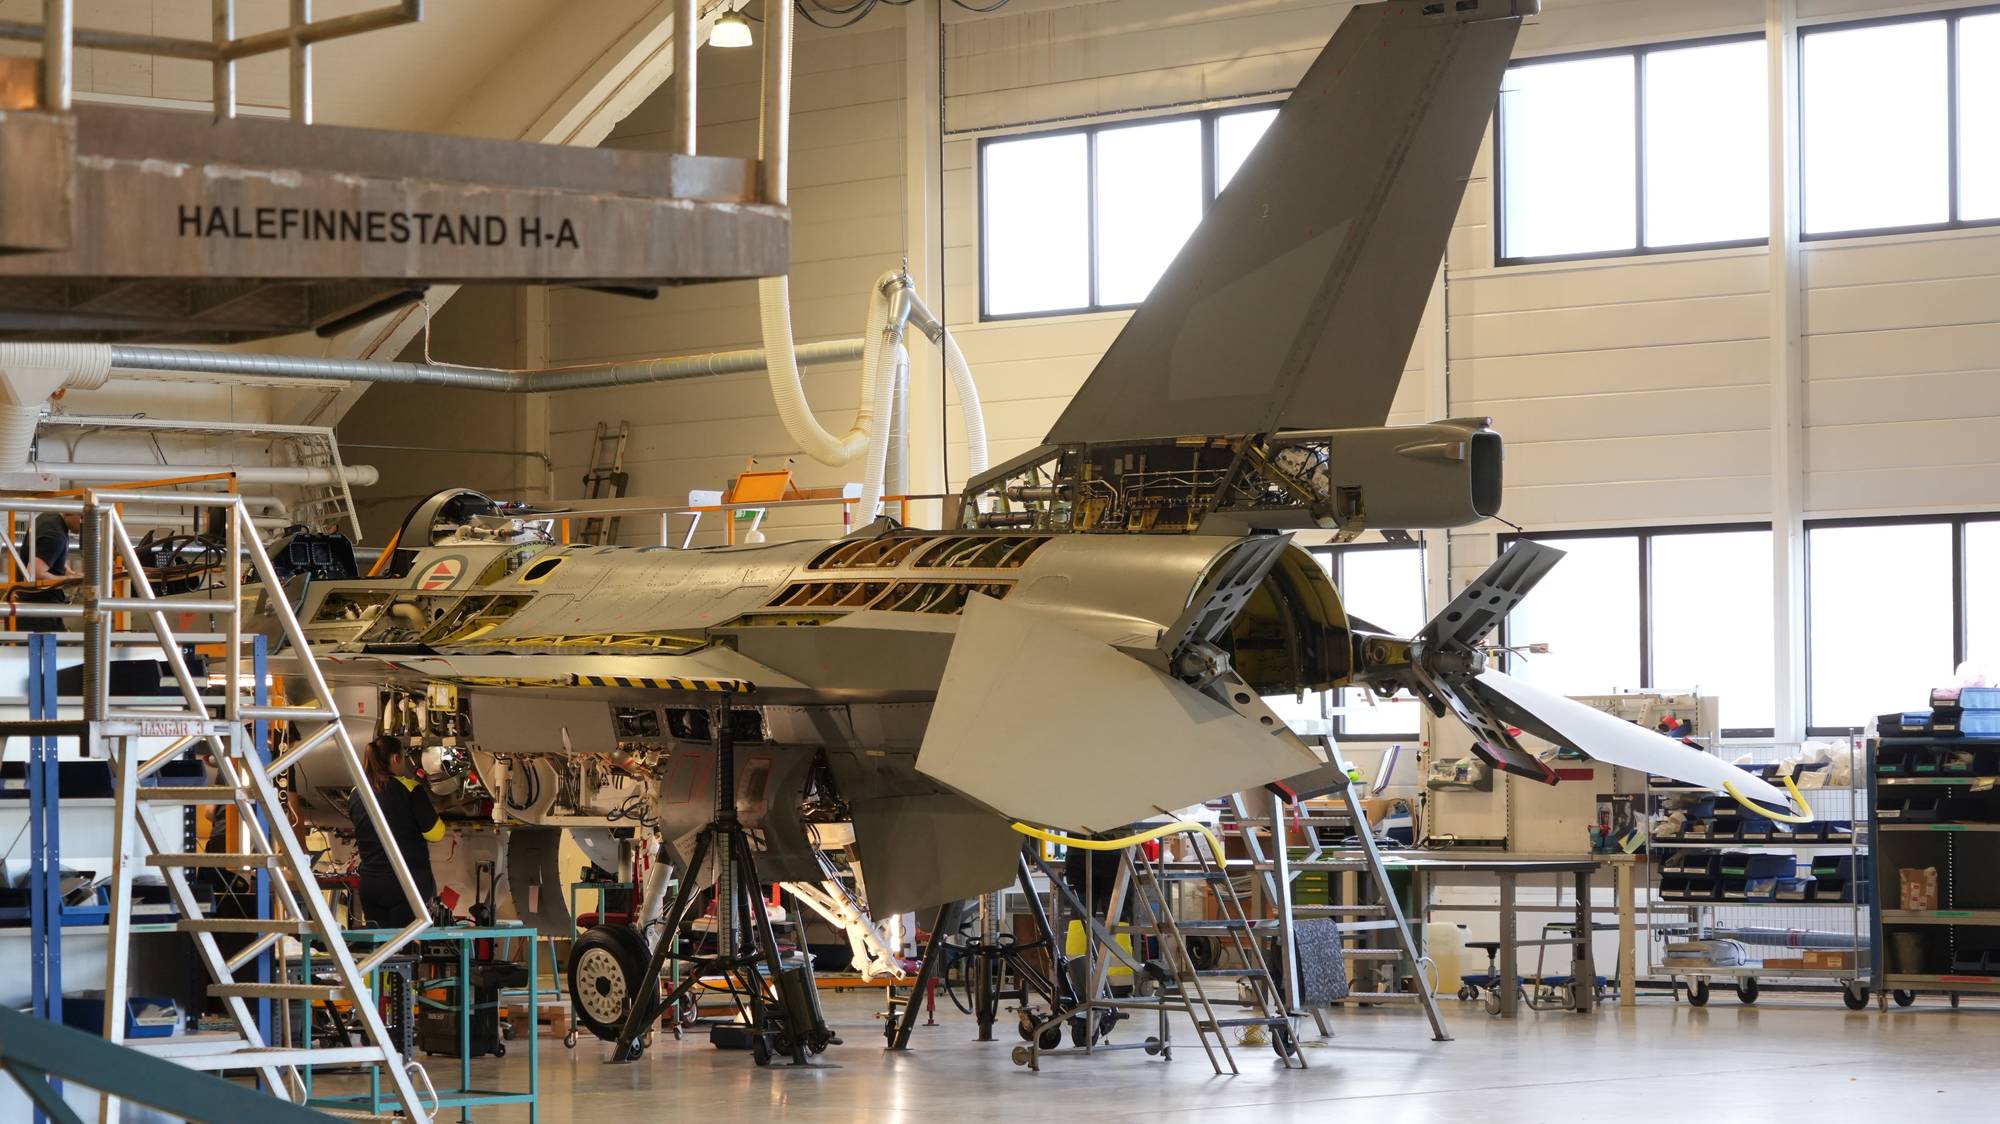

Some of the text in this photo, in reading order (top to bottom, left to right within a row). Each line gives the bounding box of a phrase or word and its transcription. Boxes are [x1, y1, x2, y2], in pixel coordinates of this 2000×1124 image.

[178, 204, 579, 249] HALEFINNESTAND H-A
[140, 720, 188, 736] HANGAR
